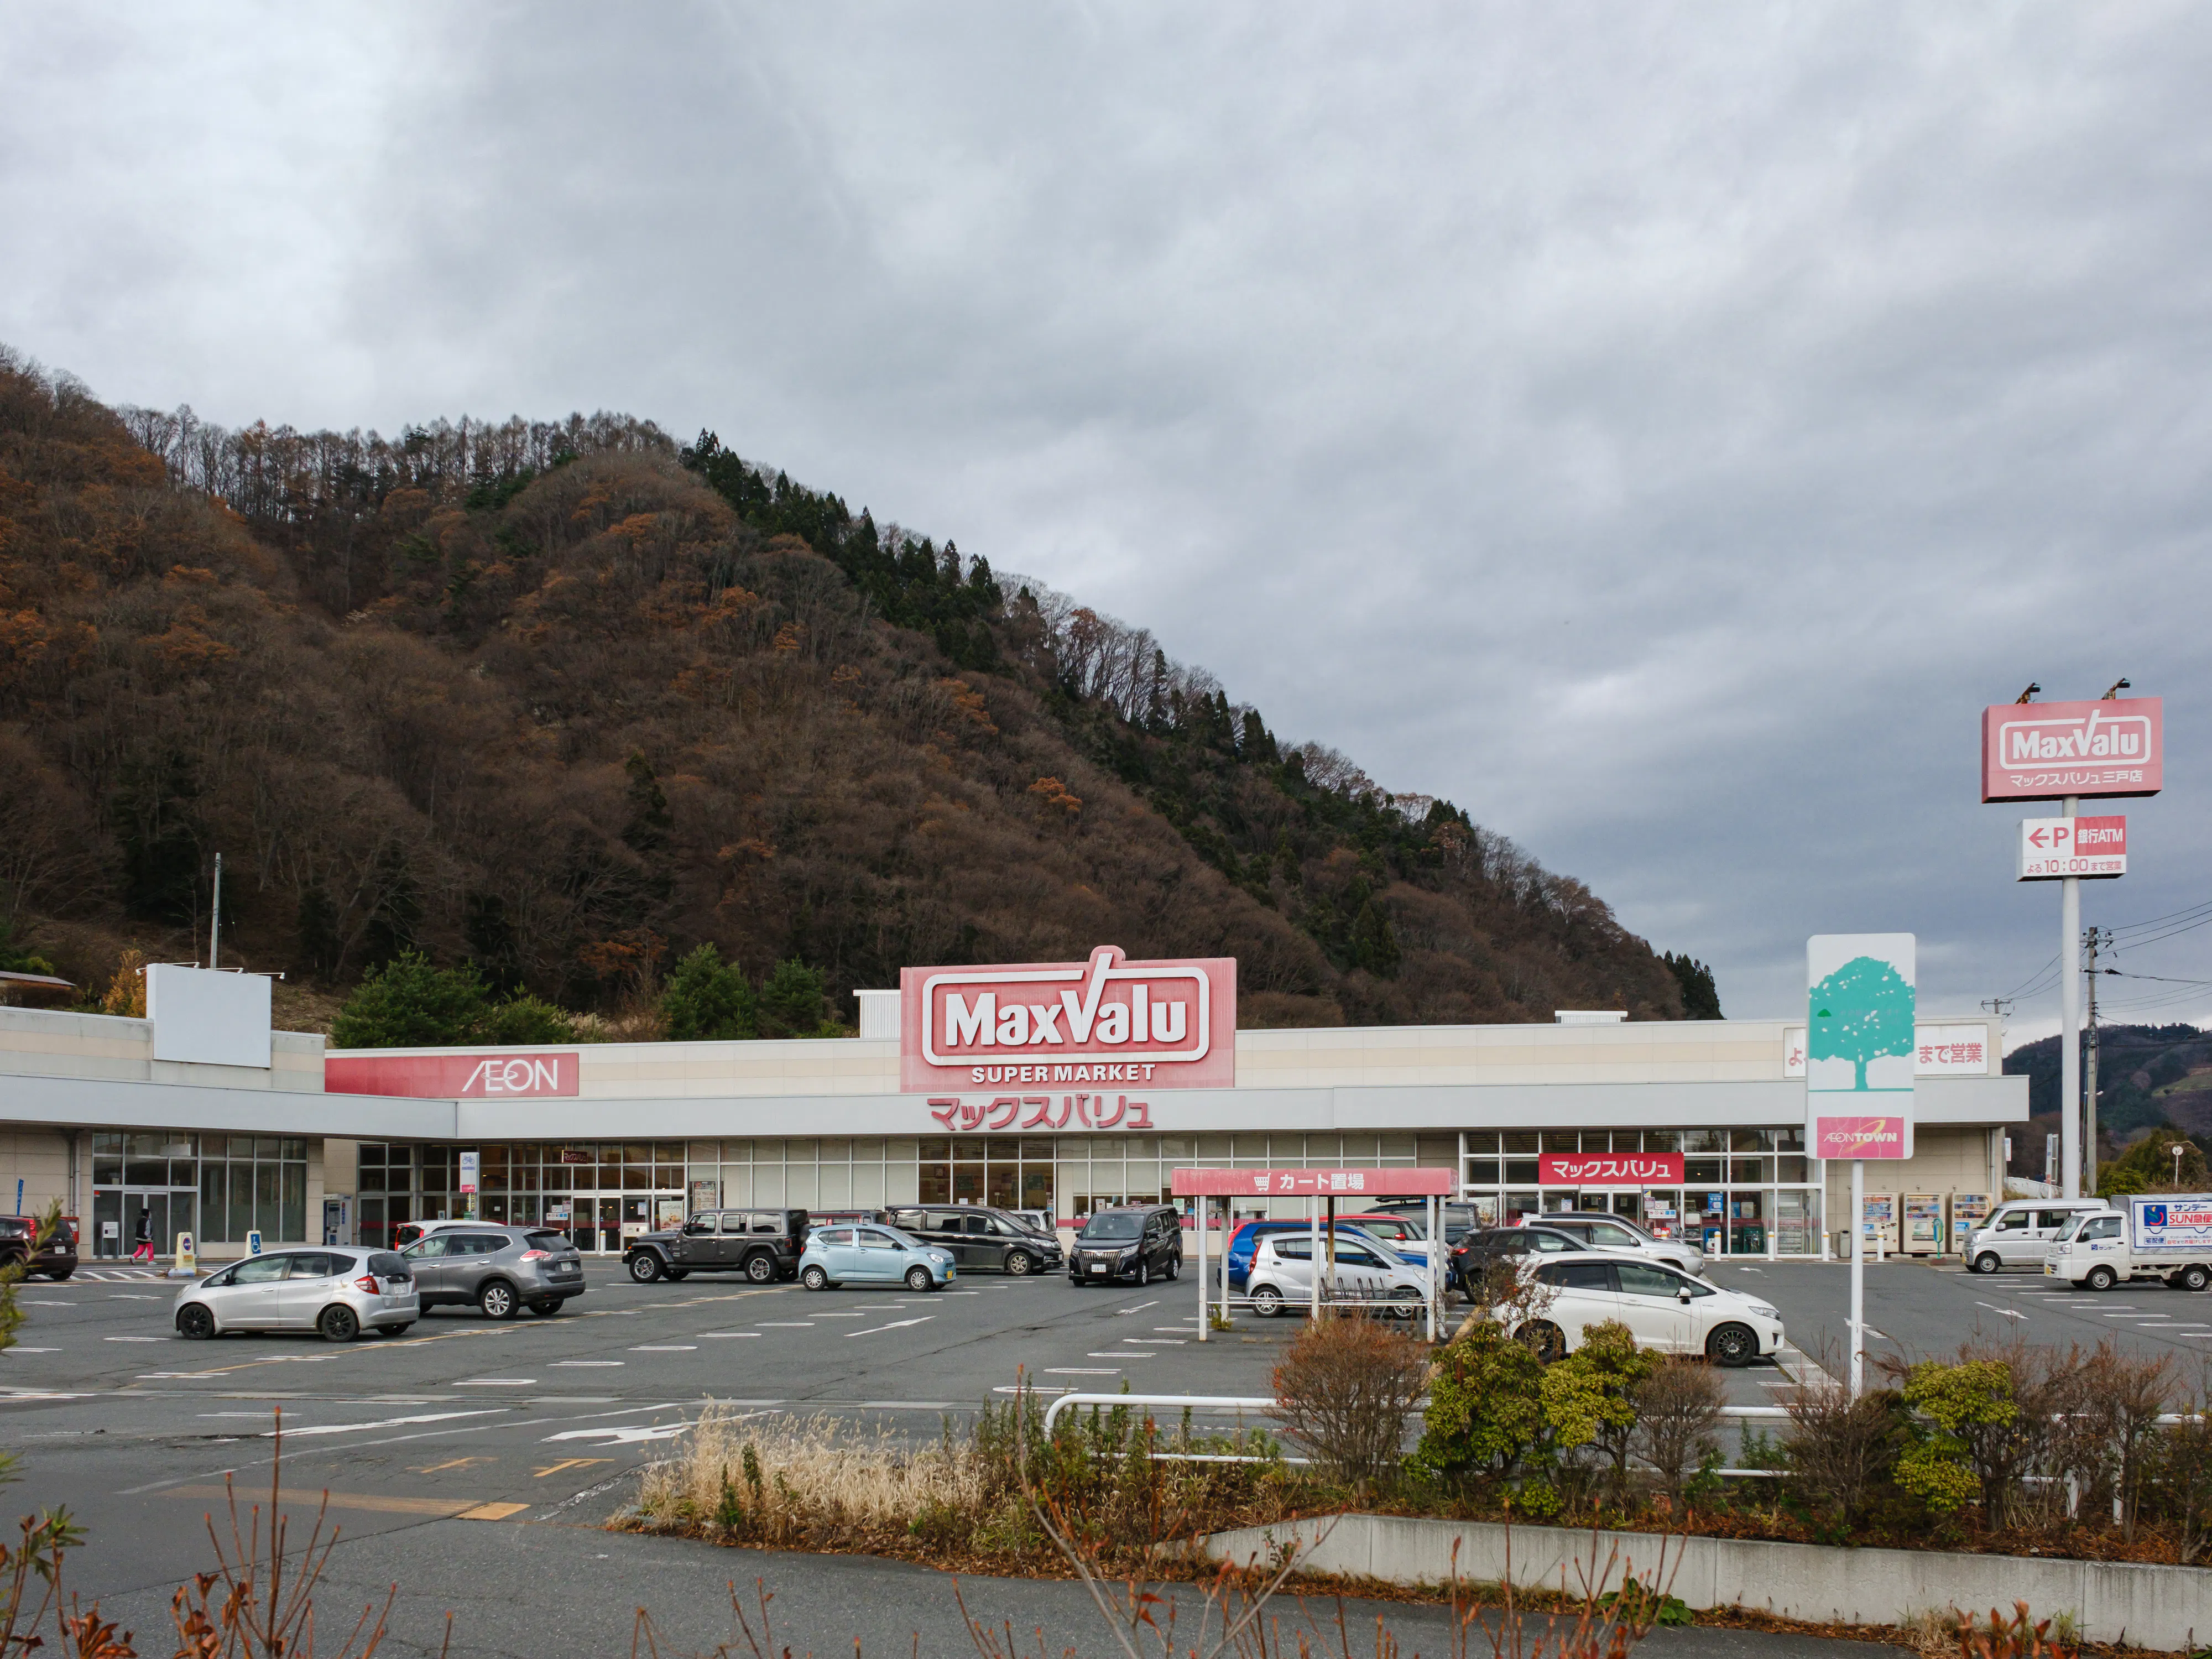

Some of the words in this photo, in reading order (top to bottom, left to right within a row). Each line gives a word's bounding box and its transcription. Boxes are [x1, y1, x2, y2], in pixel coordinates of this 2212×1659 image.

[2013, 709, 2139, 759] MaxValu
[2010, 770, 2143, 787] マックスバリュ三戸店
[2053, 827, 2069, 848] P
[2078, 828, 2124, 844] 銀行ATM
[946, 953, 1186, 1046] MaxValu
[1788, 1047, 1806, 1066] よ
[1918, 1042, 1983, 1064] まで営業
[972, 1065, 1049, 1083] SUPER
[1054, 1064, 1156, 1082] MARKET
[927, 1093, 1154, 1131] マックスバリュ
[1551, 1160, 1671, 1178] マックスバリュ
[1280, 1173, 1365, 1191] カート置場
[2169, 1214, 2212, 1224] SUN急便
